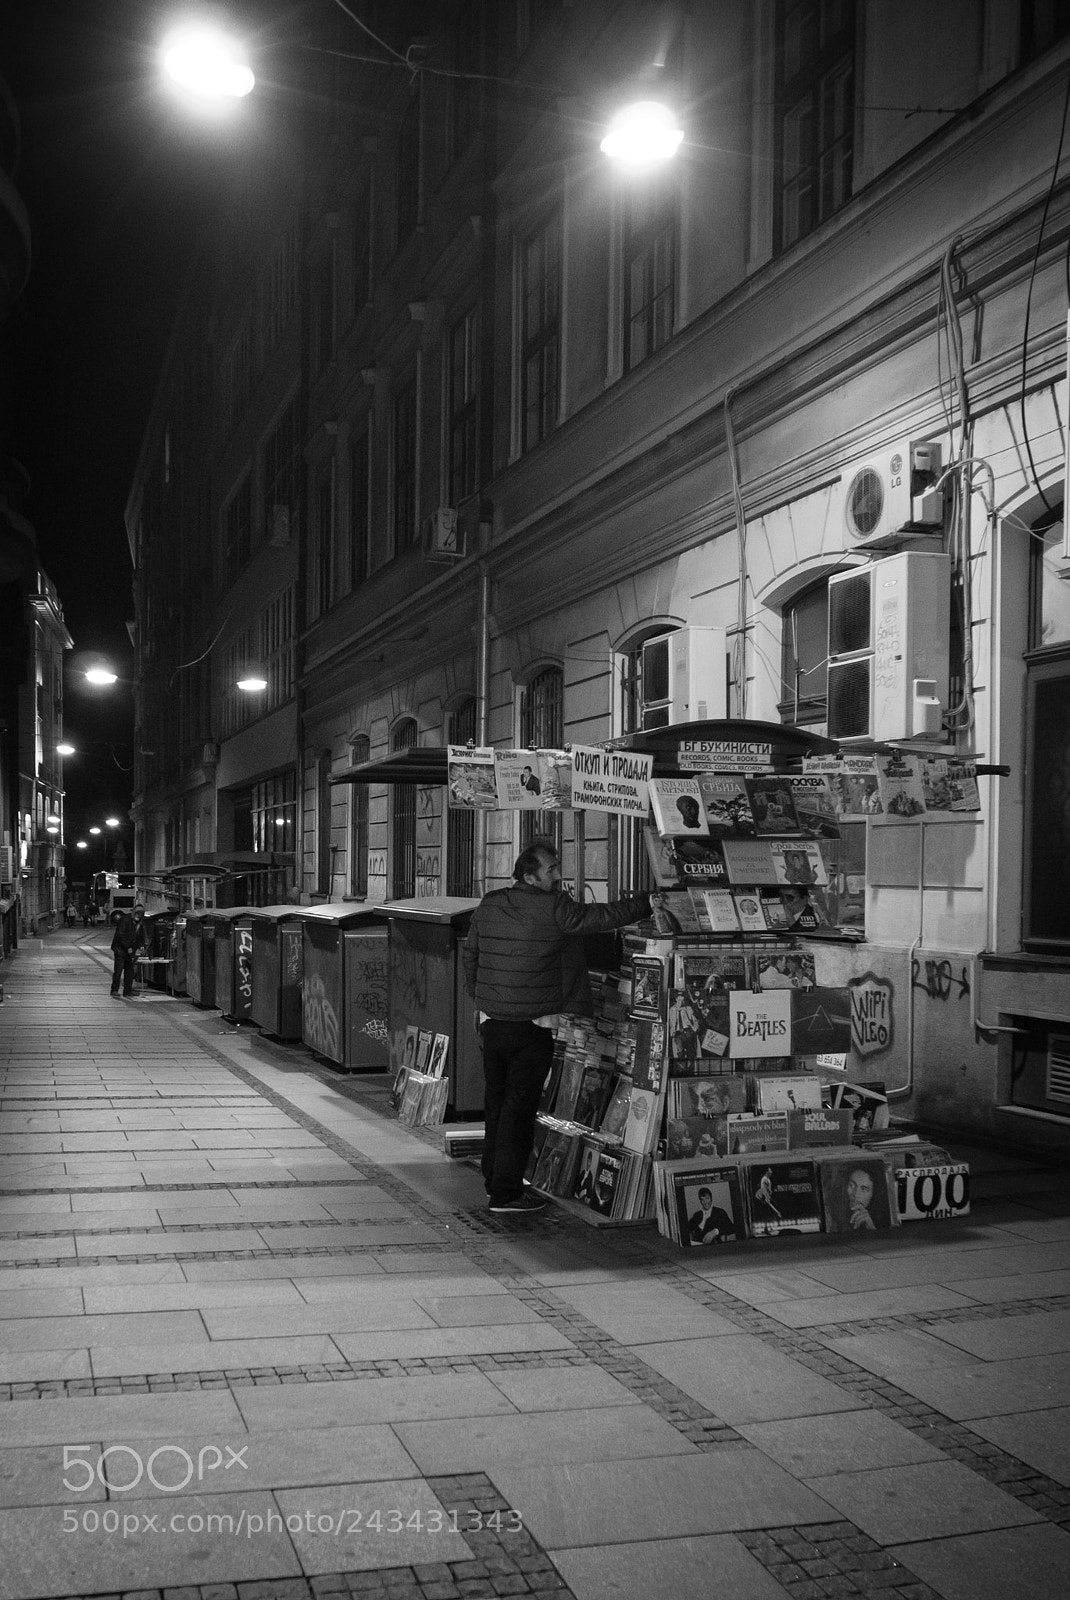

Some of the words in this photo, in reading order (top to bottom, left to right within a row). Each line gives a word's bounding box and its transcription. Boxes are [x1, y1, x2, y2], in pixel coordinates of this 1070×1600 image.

[891, 476, 901, 488] LG
[684, 741, 698, 752] БГ
[700, 742, 770, 754] БУКИНИСТИ
[574, 751, 601, 776] ОТКУП
[603, 754, 610, 776] И
[612, 756, 648, 782] ПРОДАЈА
[702, 782, 742, 793] СРБИЈА
[791, 778, 826, 786] ОСКВА
[683, 863, 725, 874] СЕРБИЯ
[804, 1121, 840, 1131] BALLADS
[897, 1165, 968, 1178] РАСПРОДАЈА
[895, 1172, 970, 1214] 100
